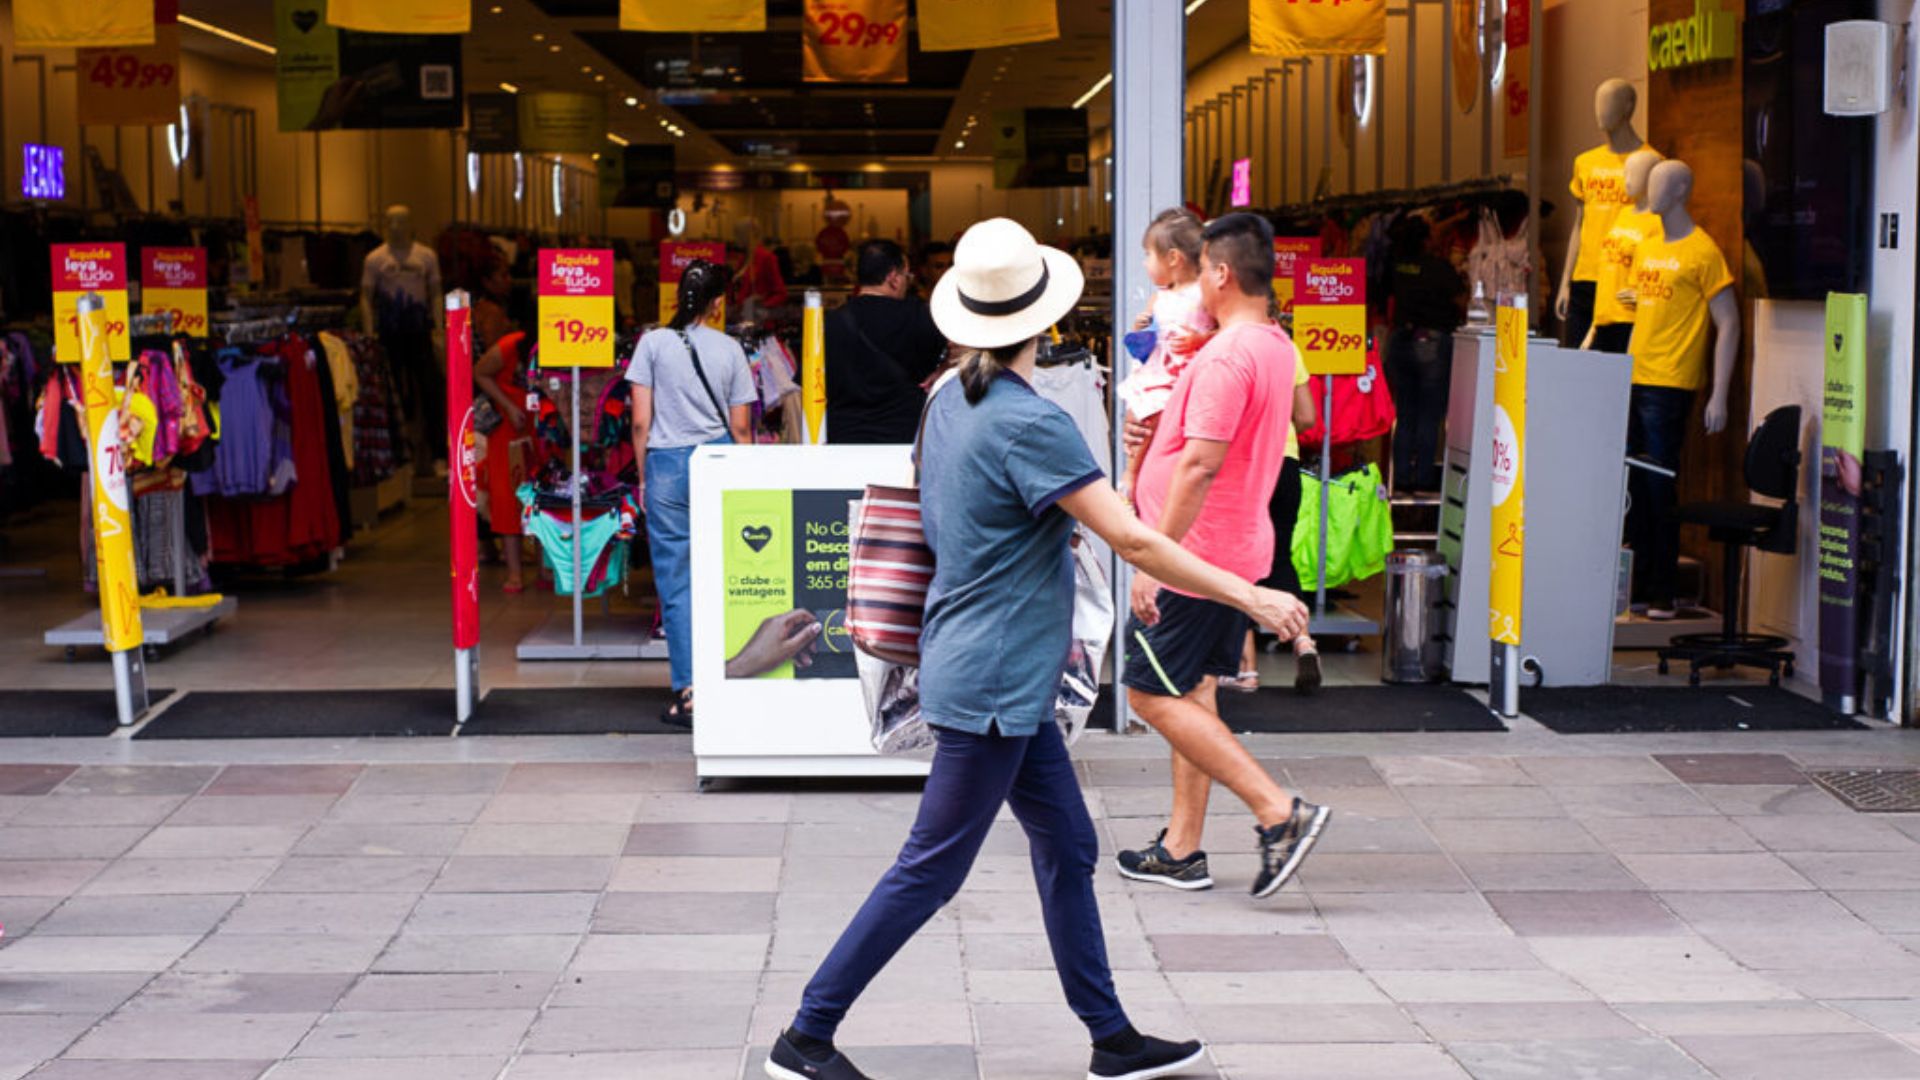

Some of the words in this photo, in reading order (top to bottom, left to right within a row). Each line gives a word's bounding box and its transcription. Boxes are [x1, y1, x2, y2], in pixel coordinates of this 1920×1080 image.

[819, 12, 898, 47] 29,99
[1648, 0, 1713, 71] caedu
[90, 53, 175, 90] 49,99
[556, 254, 599, 267] liquida
[1275, 252, 1296, 261] eva
[65, 257, 97, 272] leva
[552, 262, 584, 277] leva
[1310, 264, 1352, 275] liquida
[79, 267, 114, 281] tudo
[565, 273, 600, 287] tudo
[1306, 272, 1337, 285] leva
[1320, 282, 1353, 296] tudo
[555, 320, 608, 344] 19,99
[1306, 328, 1362, 352] 29,99
[805, 522, 828, 537] No
[805, 540, 850, 554] Desco
[806, 562, 830, 571] em
[833, 557, 849, 571] di
[740, 575, 770, 585] clube
[805, 576, 832, 590] 365
[836, 575, 849, 589] di
[728, 586, 787, 598] vantagens
